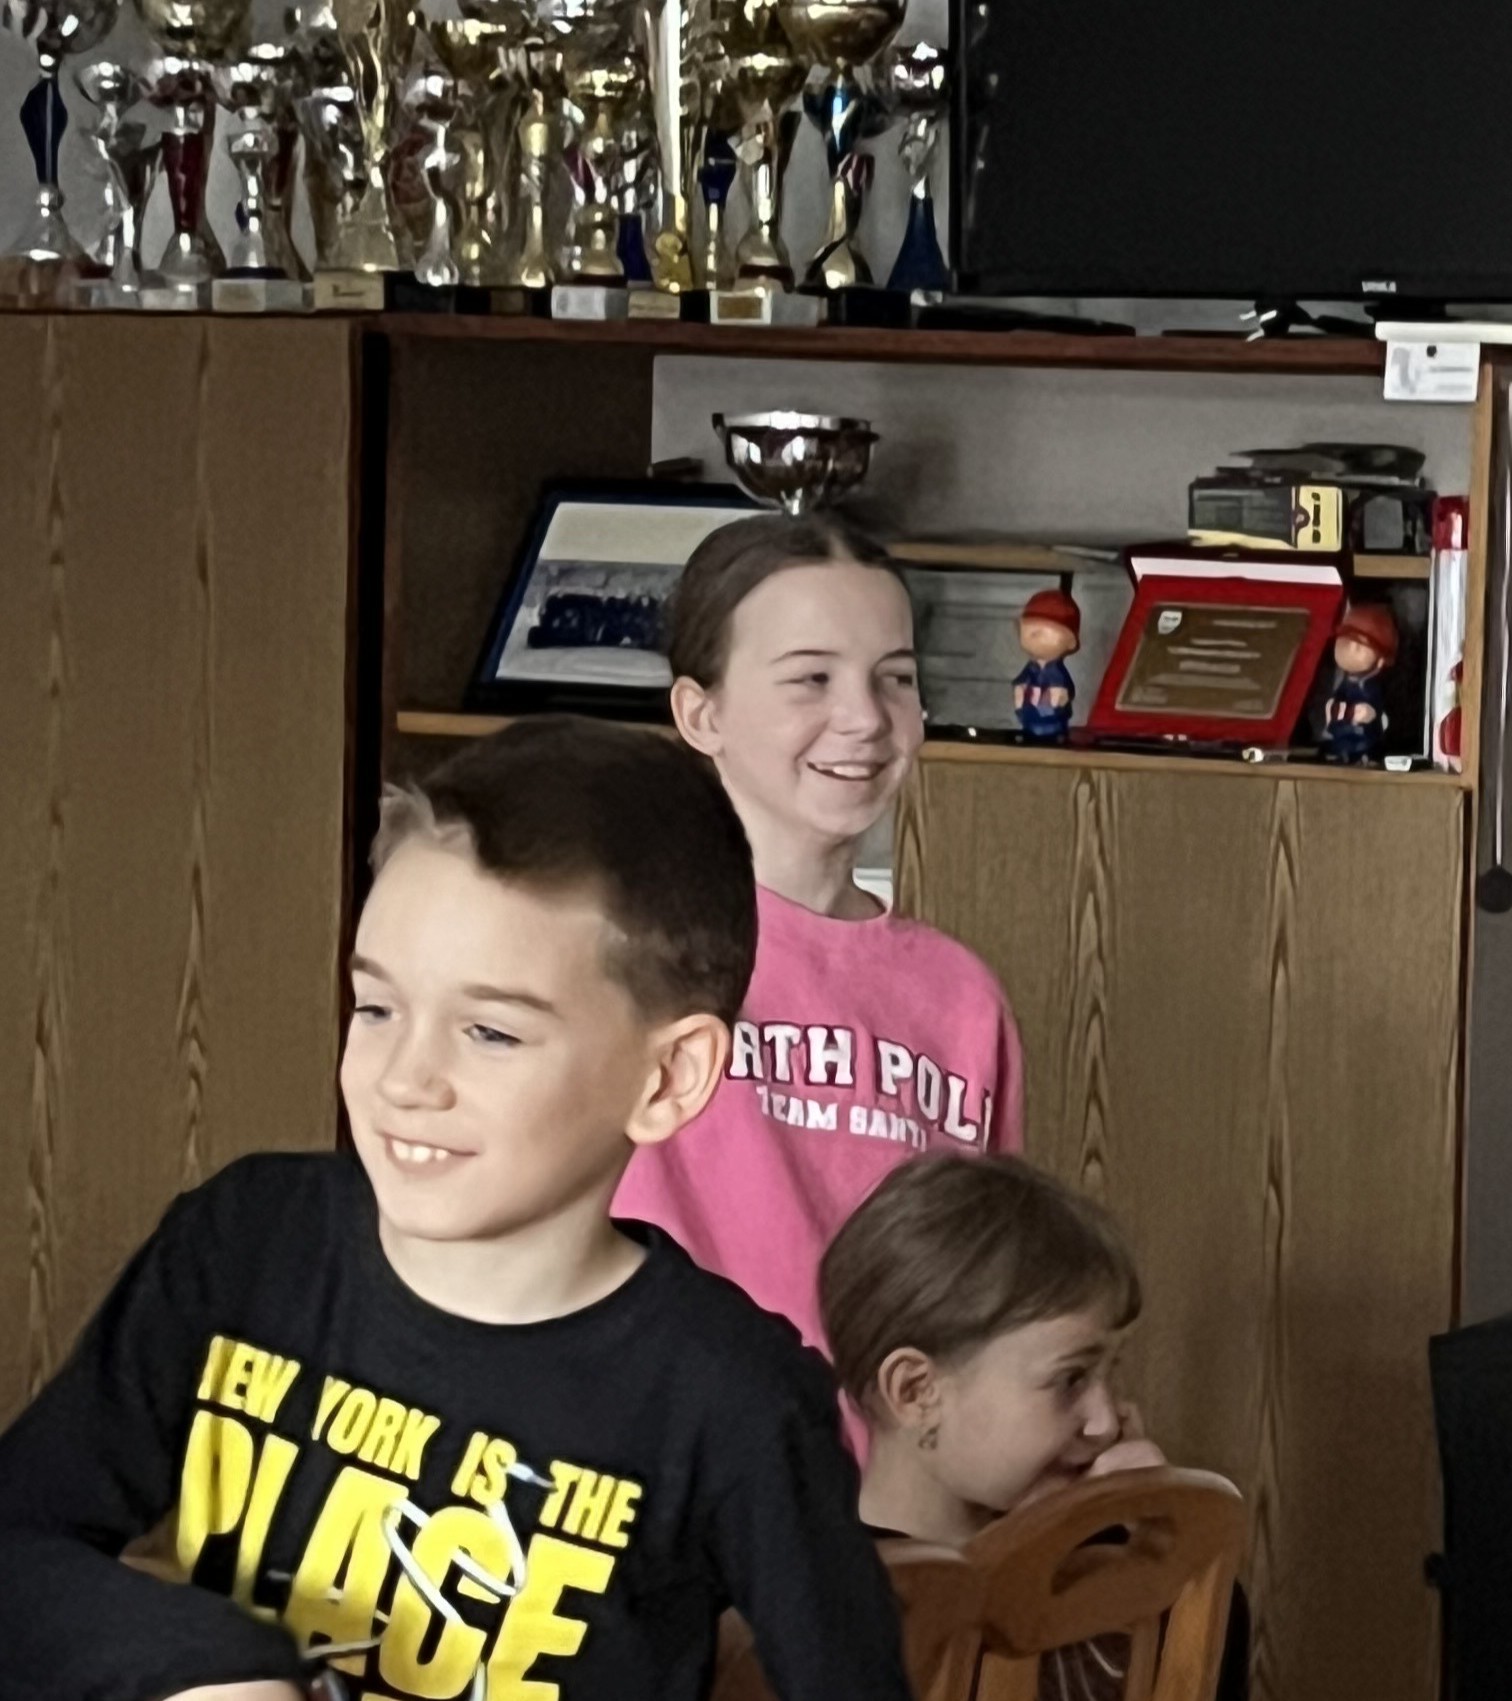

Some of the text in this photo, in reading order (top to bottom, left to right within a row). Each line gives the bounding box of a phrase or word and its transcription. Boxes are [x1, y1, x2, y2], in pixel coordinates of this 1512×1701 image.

[756, 1085, 839, 1132] TEAM
[311, 1374, 442, 1481] YORK
[450, 1430, 518, 1507] IS
[538, 1458, 643, 1549] THE
[176, 1409, 616, 1701] PLACE
